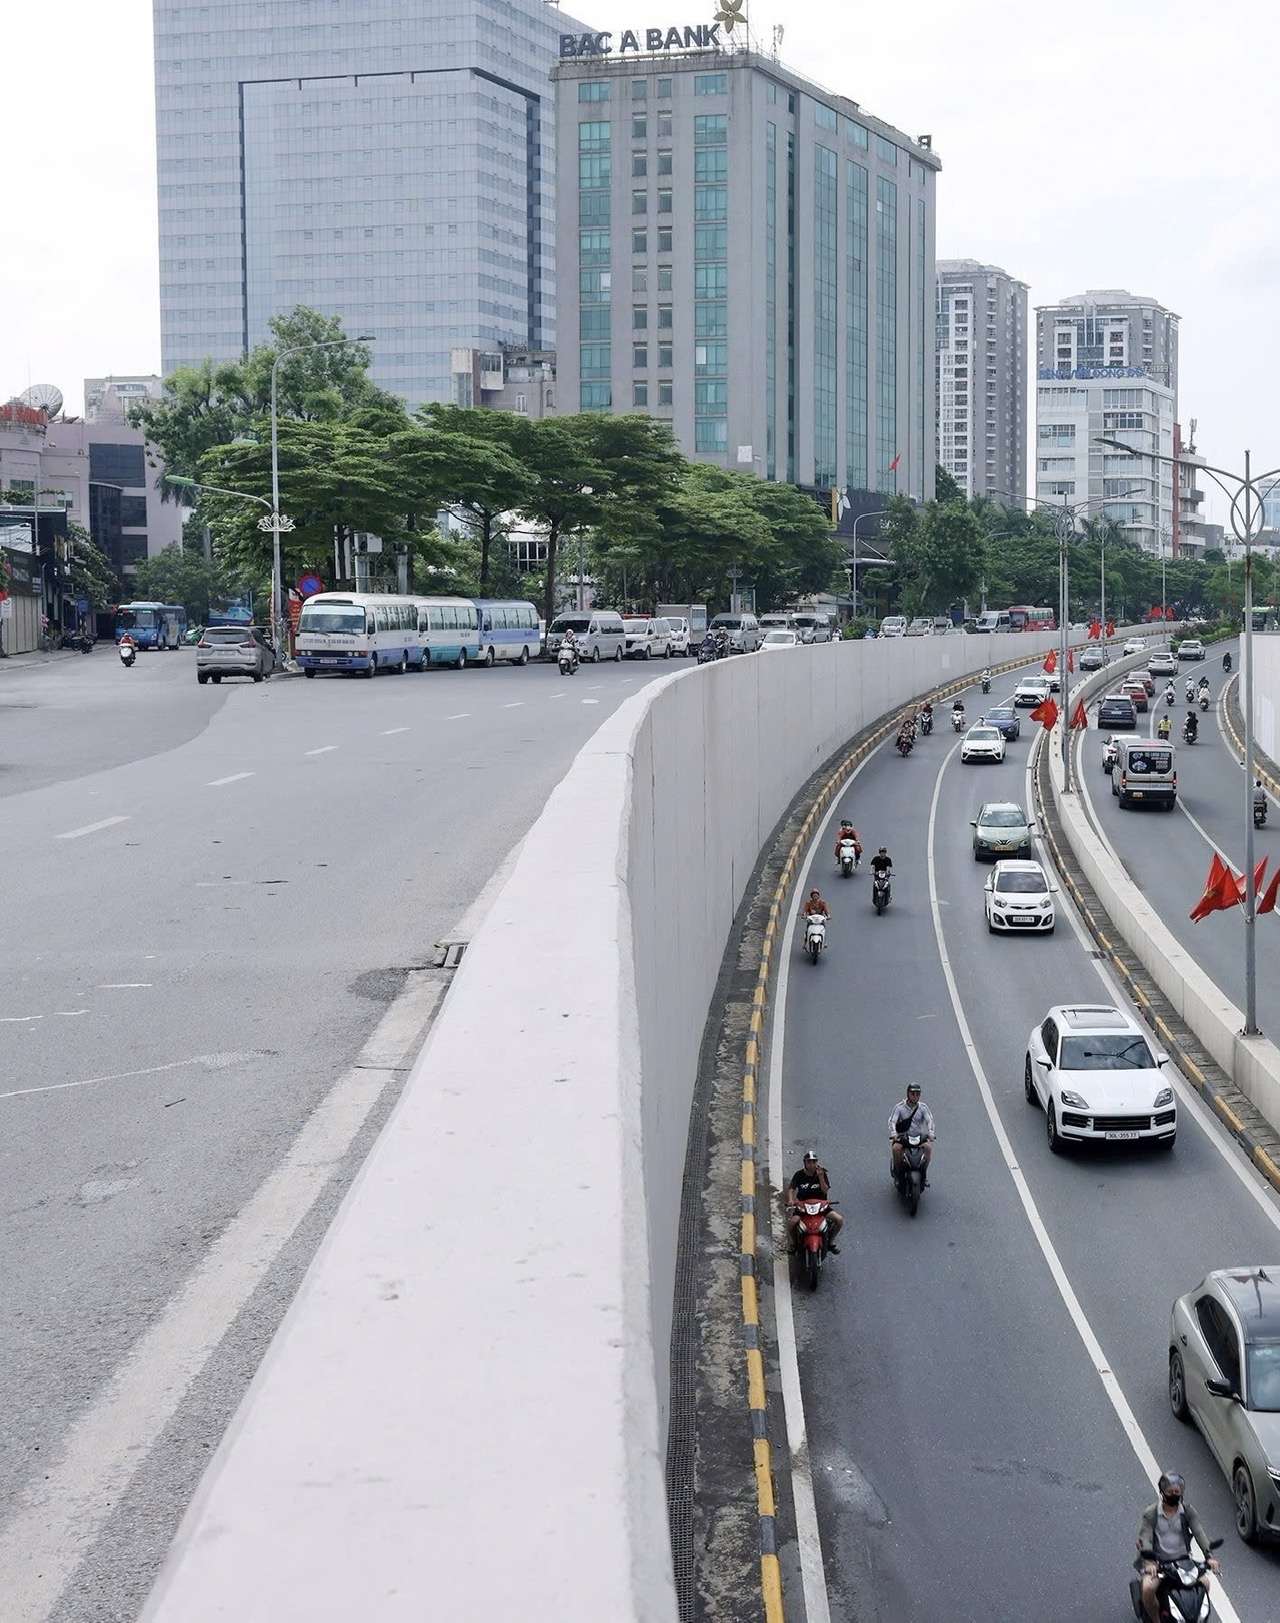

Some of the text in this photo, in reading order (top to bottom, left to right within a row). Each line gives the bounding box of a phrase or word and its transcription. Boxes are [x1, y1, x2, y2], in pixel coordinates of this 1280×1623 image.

[559, 23, 720, 57] BAC A BANK
